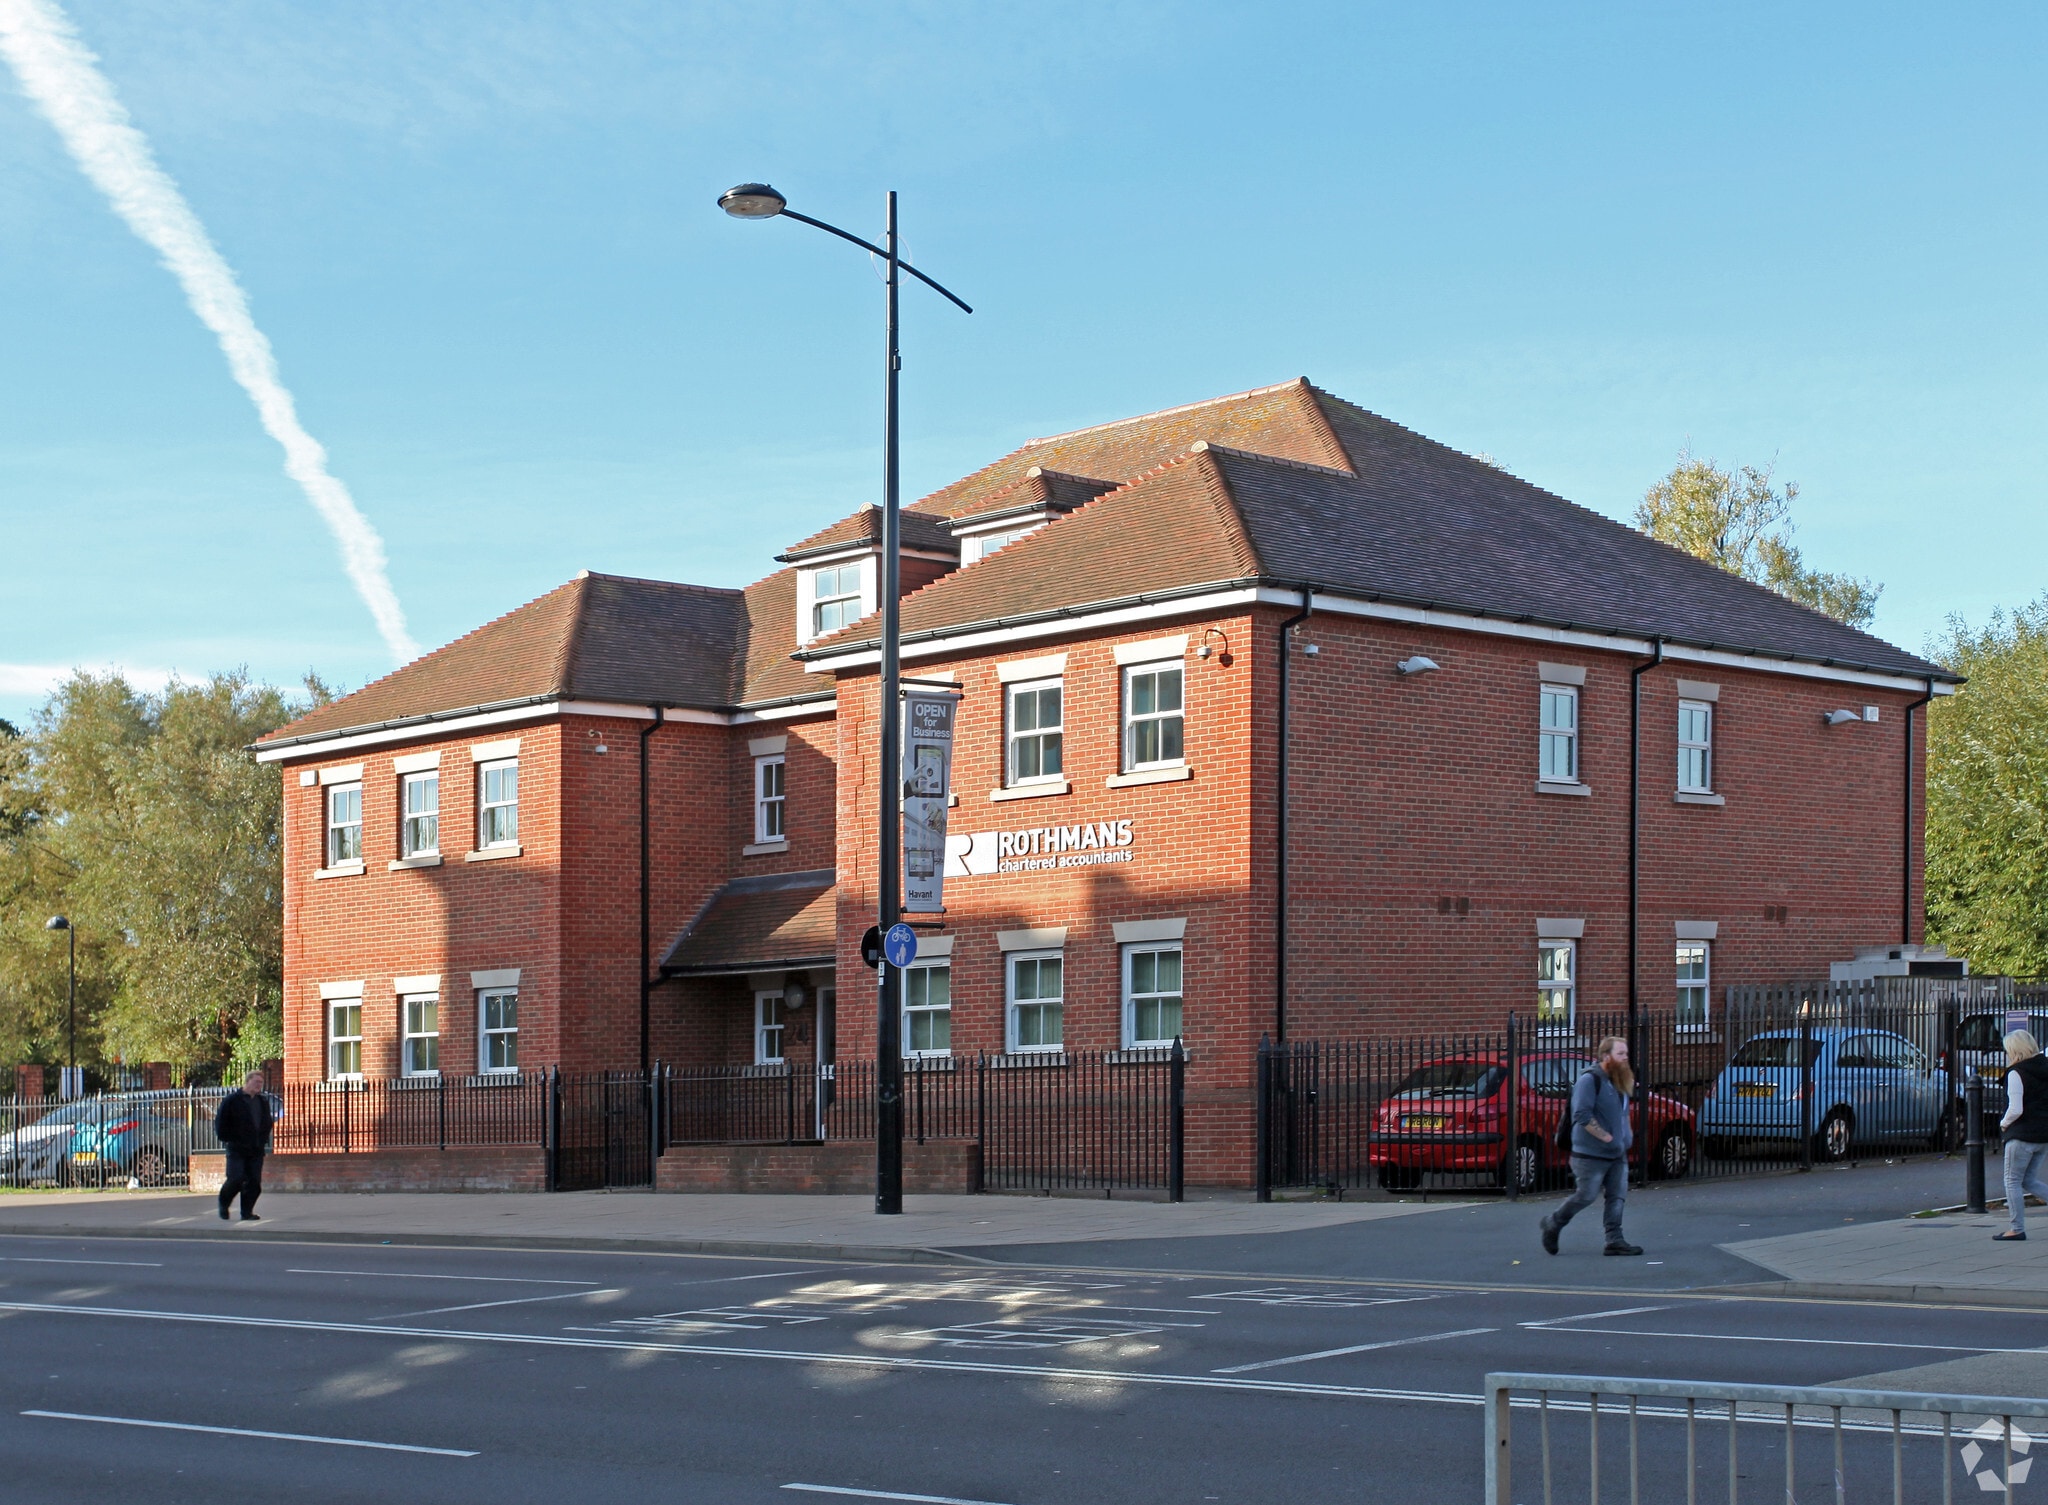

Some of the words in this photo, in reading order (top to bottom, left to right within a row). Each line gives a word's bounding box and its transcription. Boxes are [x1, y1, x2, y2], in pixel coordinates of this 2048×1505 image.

[915, 703, 947, 718] OPEN
[923, 717, 938, 727] for
[912, 726, 951, 738] Business
[998, 819, 1134, 858] ROTHMANS
[998, 856, 1057, 873] chartered
[1059, 849, 1133, 868] accountants
[908, 889, 933, 899] Havant
